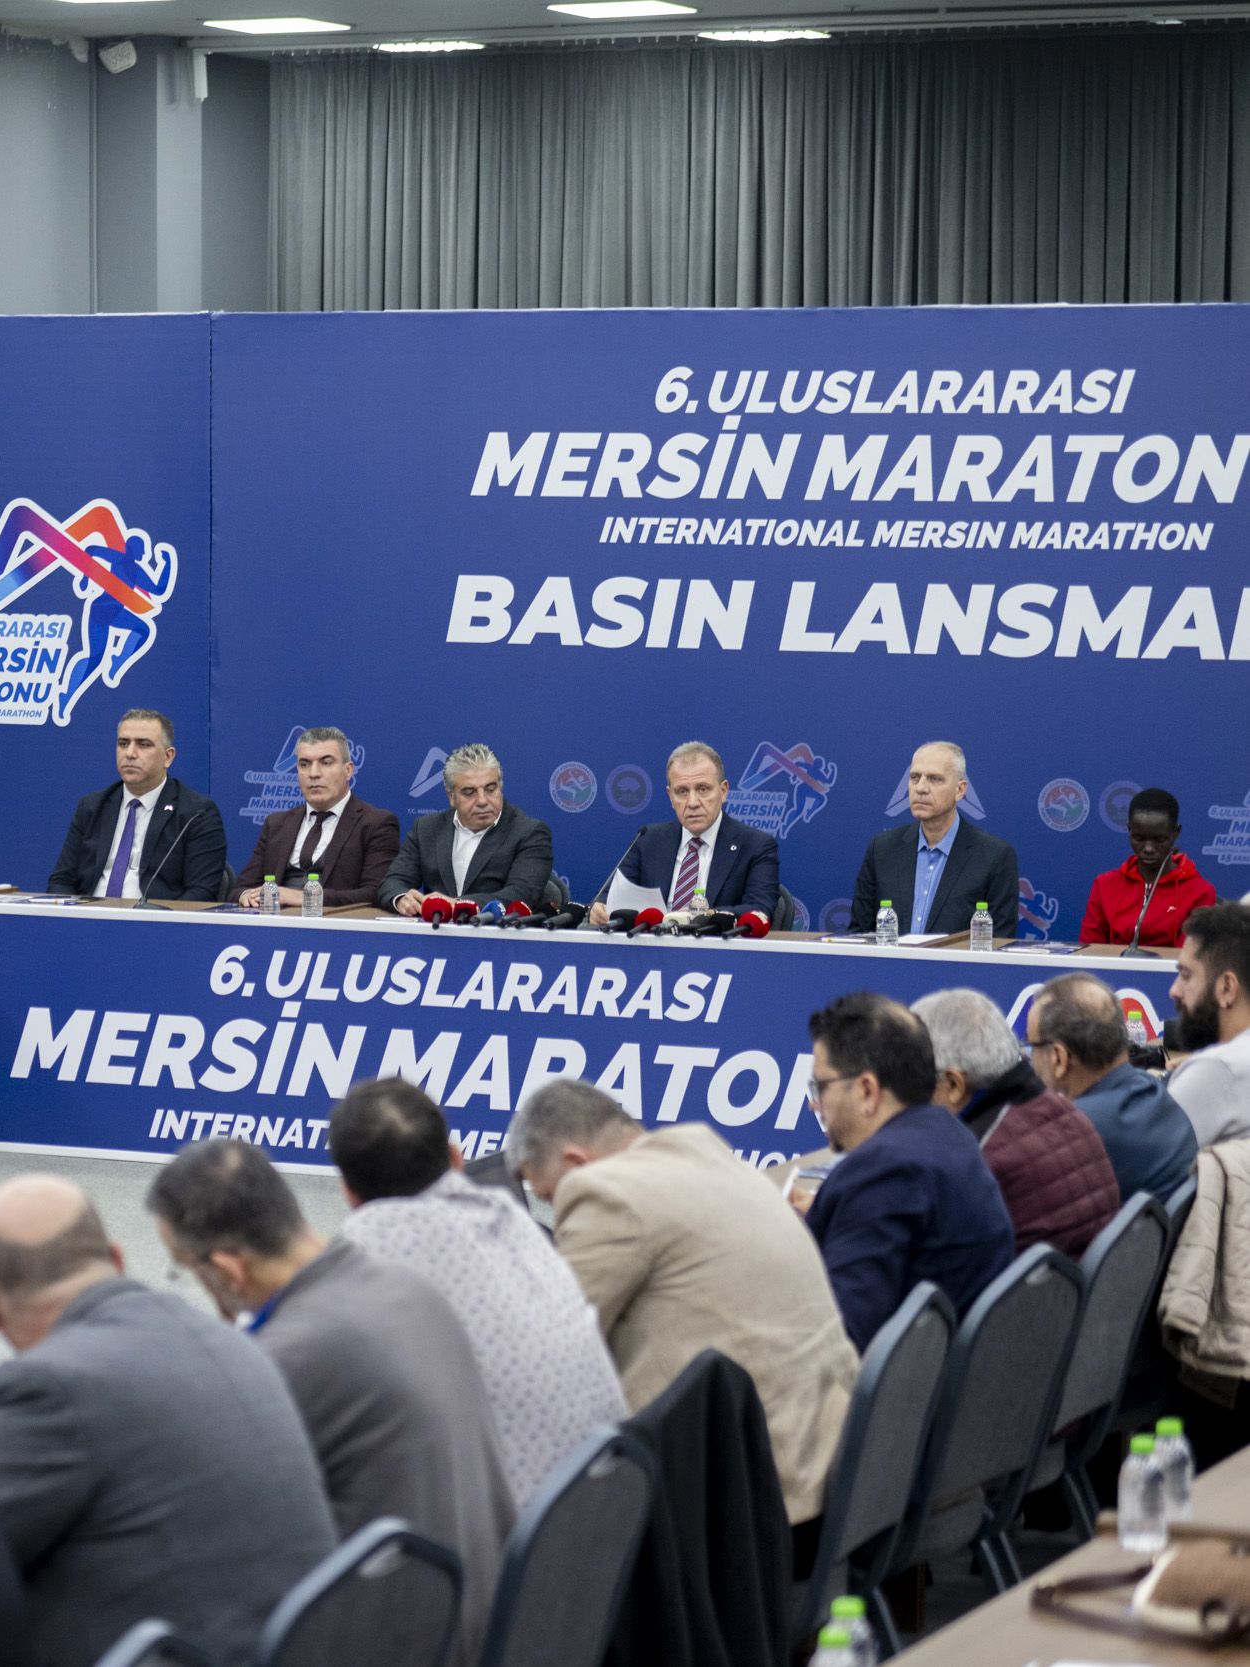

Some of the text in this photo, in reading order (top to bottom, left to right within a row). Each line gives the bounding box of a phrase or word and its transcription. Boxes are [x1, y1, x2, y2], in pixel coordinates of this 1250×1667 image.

[655, 366, 1137, 414] 6.ULUSLARARASI
[470, 414, 802, 500] MERSİN
[599, 516, 1215, 551] INTERNATIONAL MERSIN MARATHON
[445, 574, 756, 651] BASIN
[245, 773, 299, 783] 6.ULUSLARA
[727, 792, 786, 802] USLARARASI
[728, 802, 784, 817] MERSİN
[209, 945, 733, 1023] 6.ULUSLARARASI
[10, 1001, 828, 1133] MERSİN MARATON
[148, 1108, 331, 1150] INTERNAT
